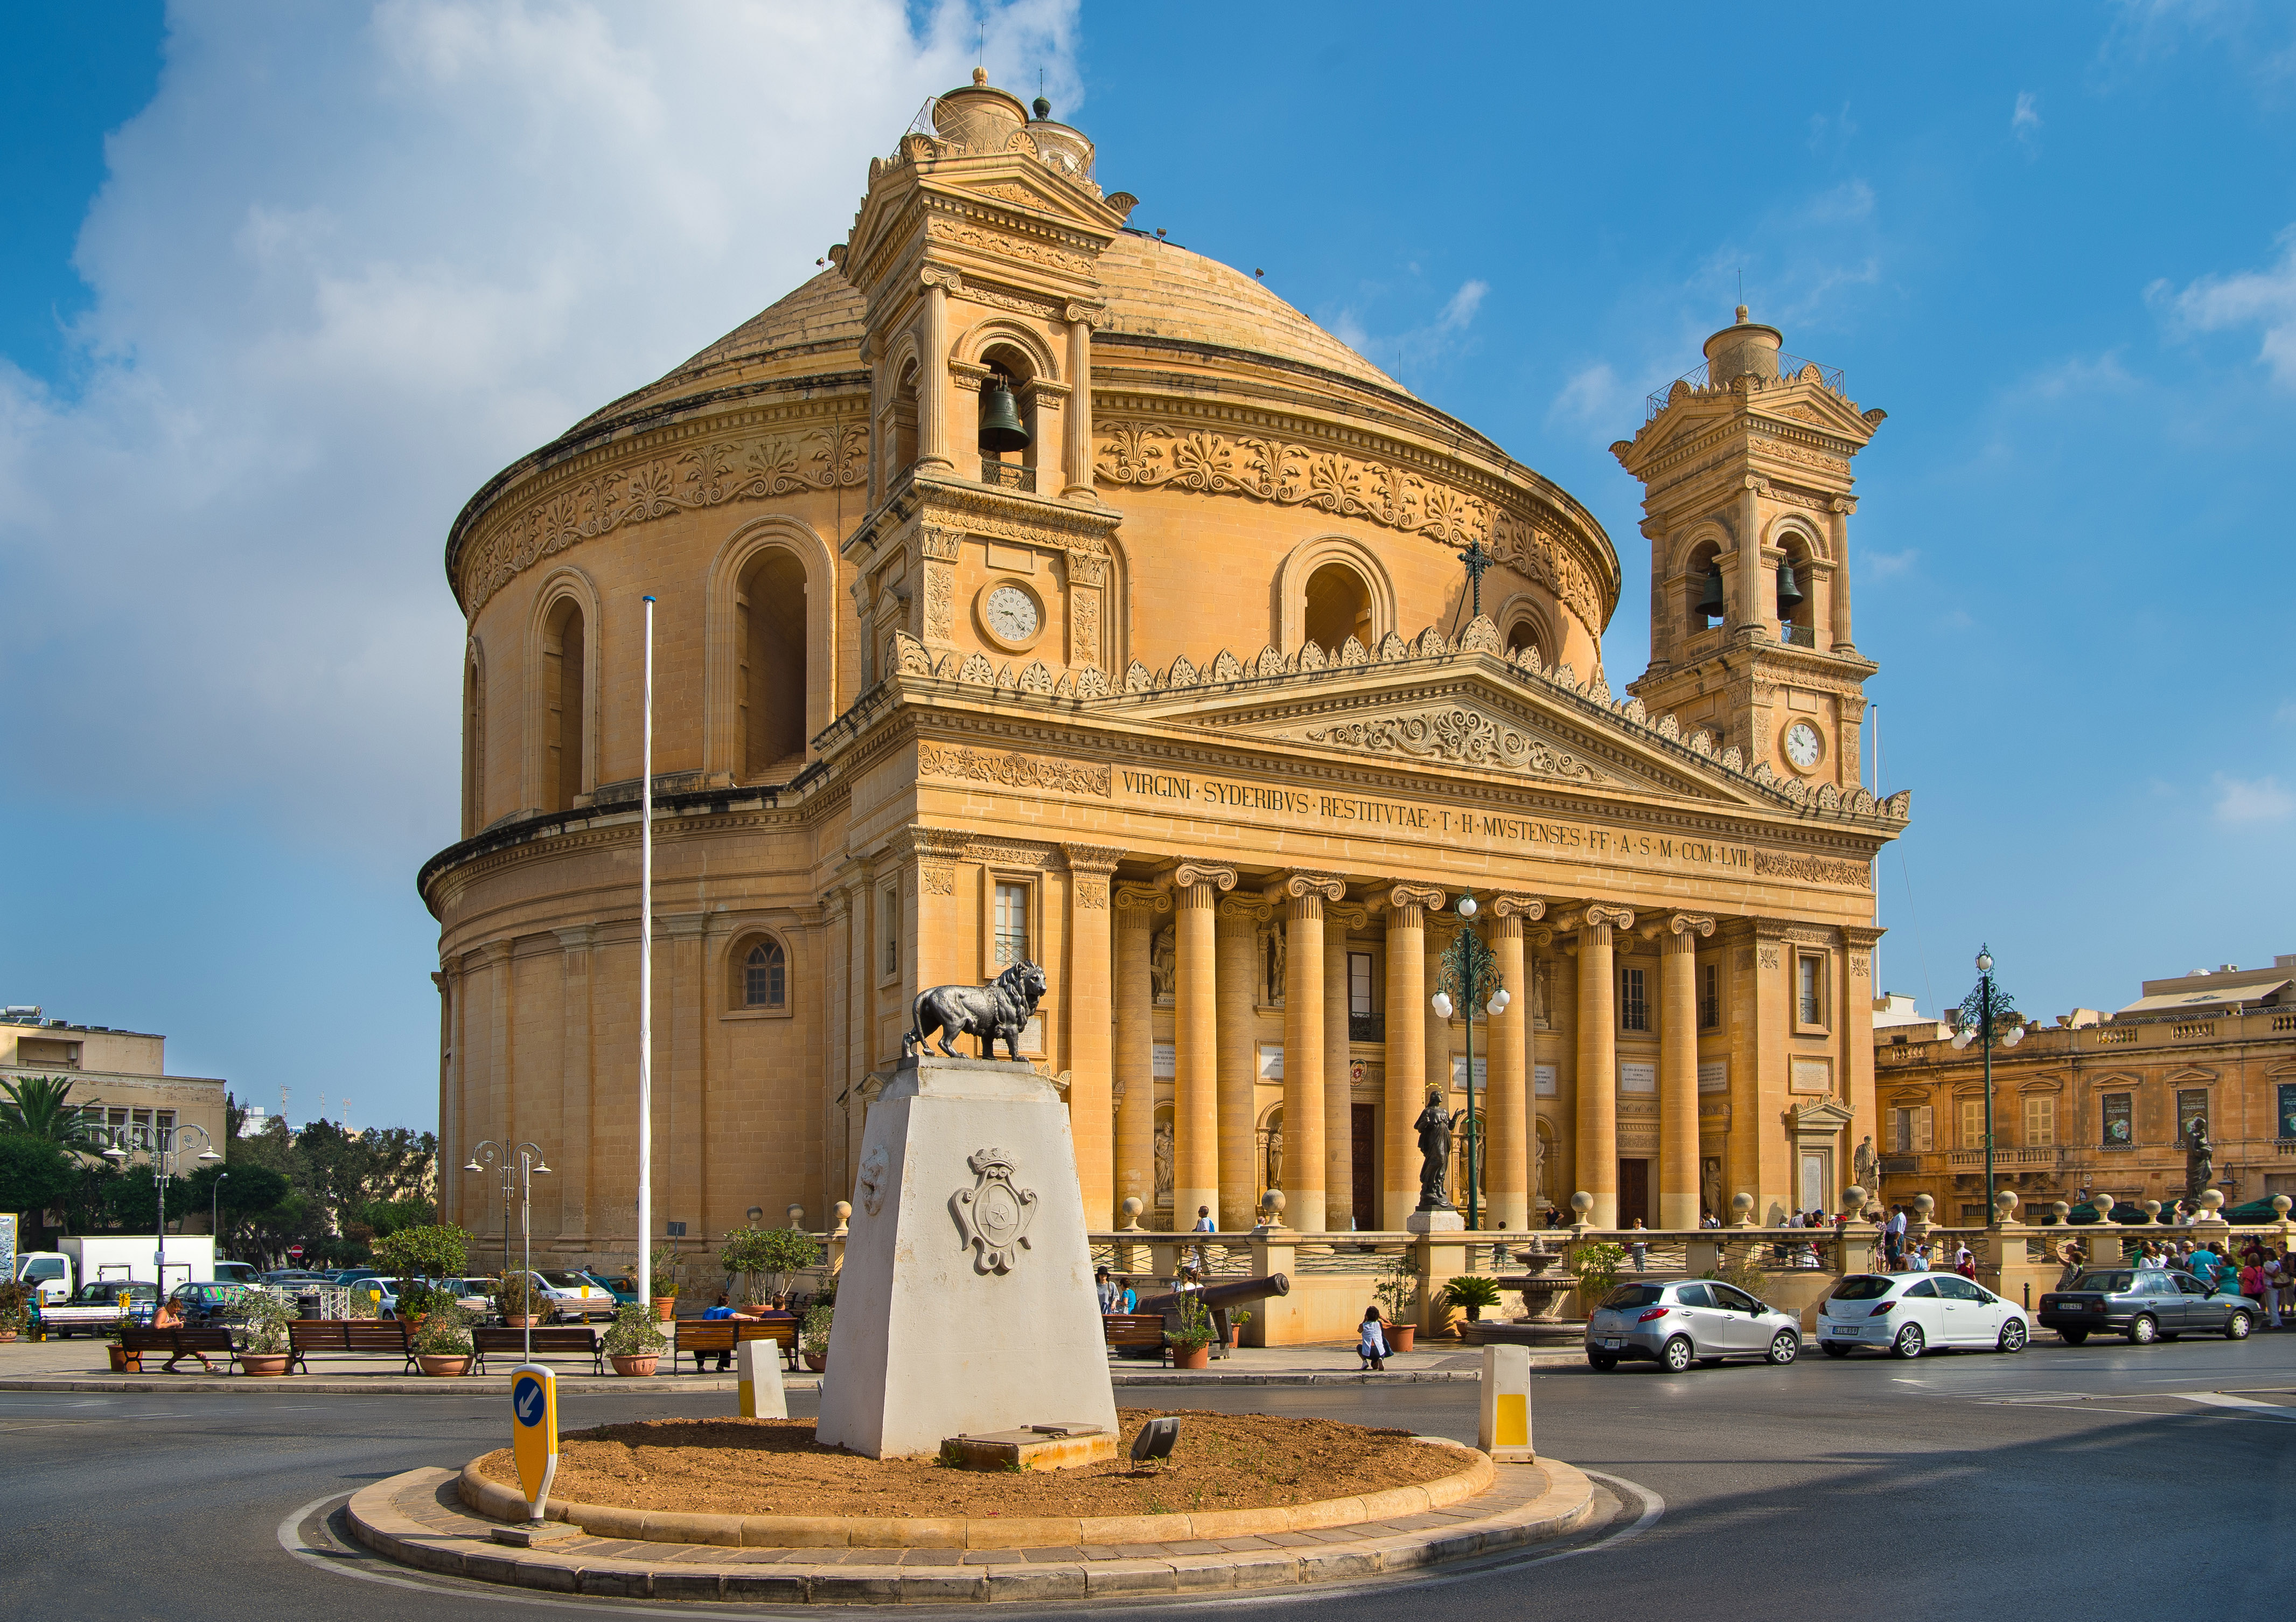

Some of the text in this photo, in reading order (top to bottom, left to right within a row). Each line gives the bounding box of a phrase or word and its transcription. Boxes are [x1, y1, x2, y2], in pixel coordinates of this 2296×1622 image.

[1122, 771, 1747, 867] VIRGINI SYDERIBVS RESTITVTAE T H MVSTENSES FF A S M CCM LVII
